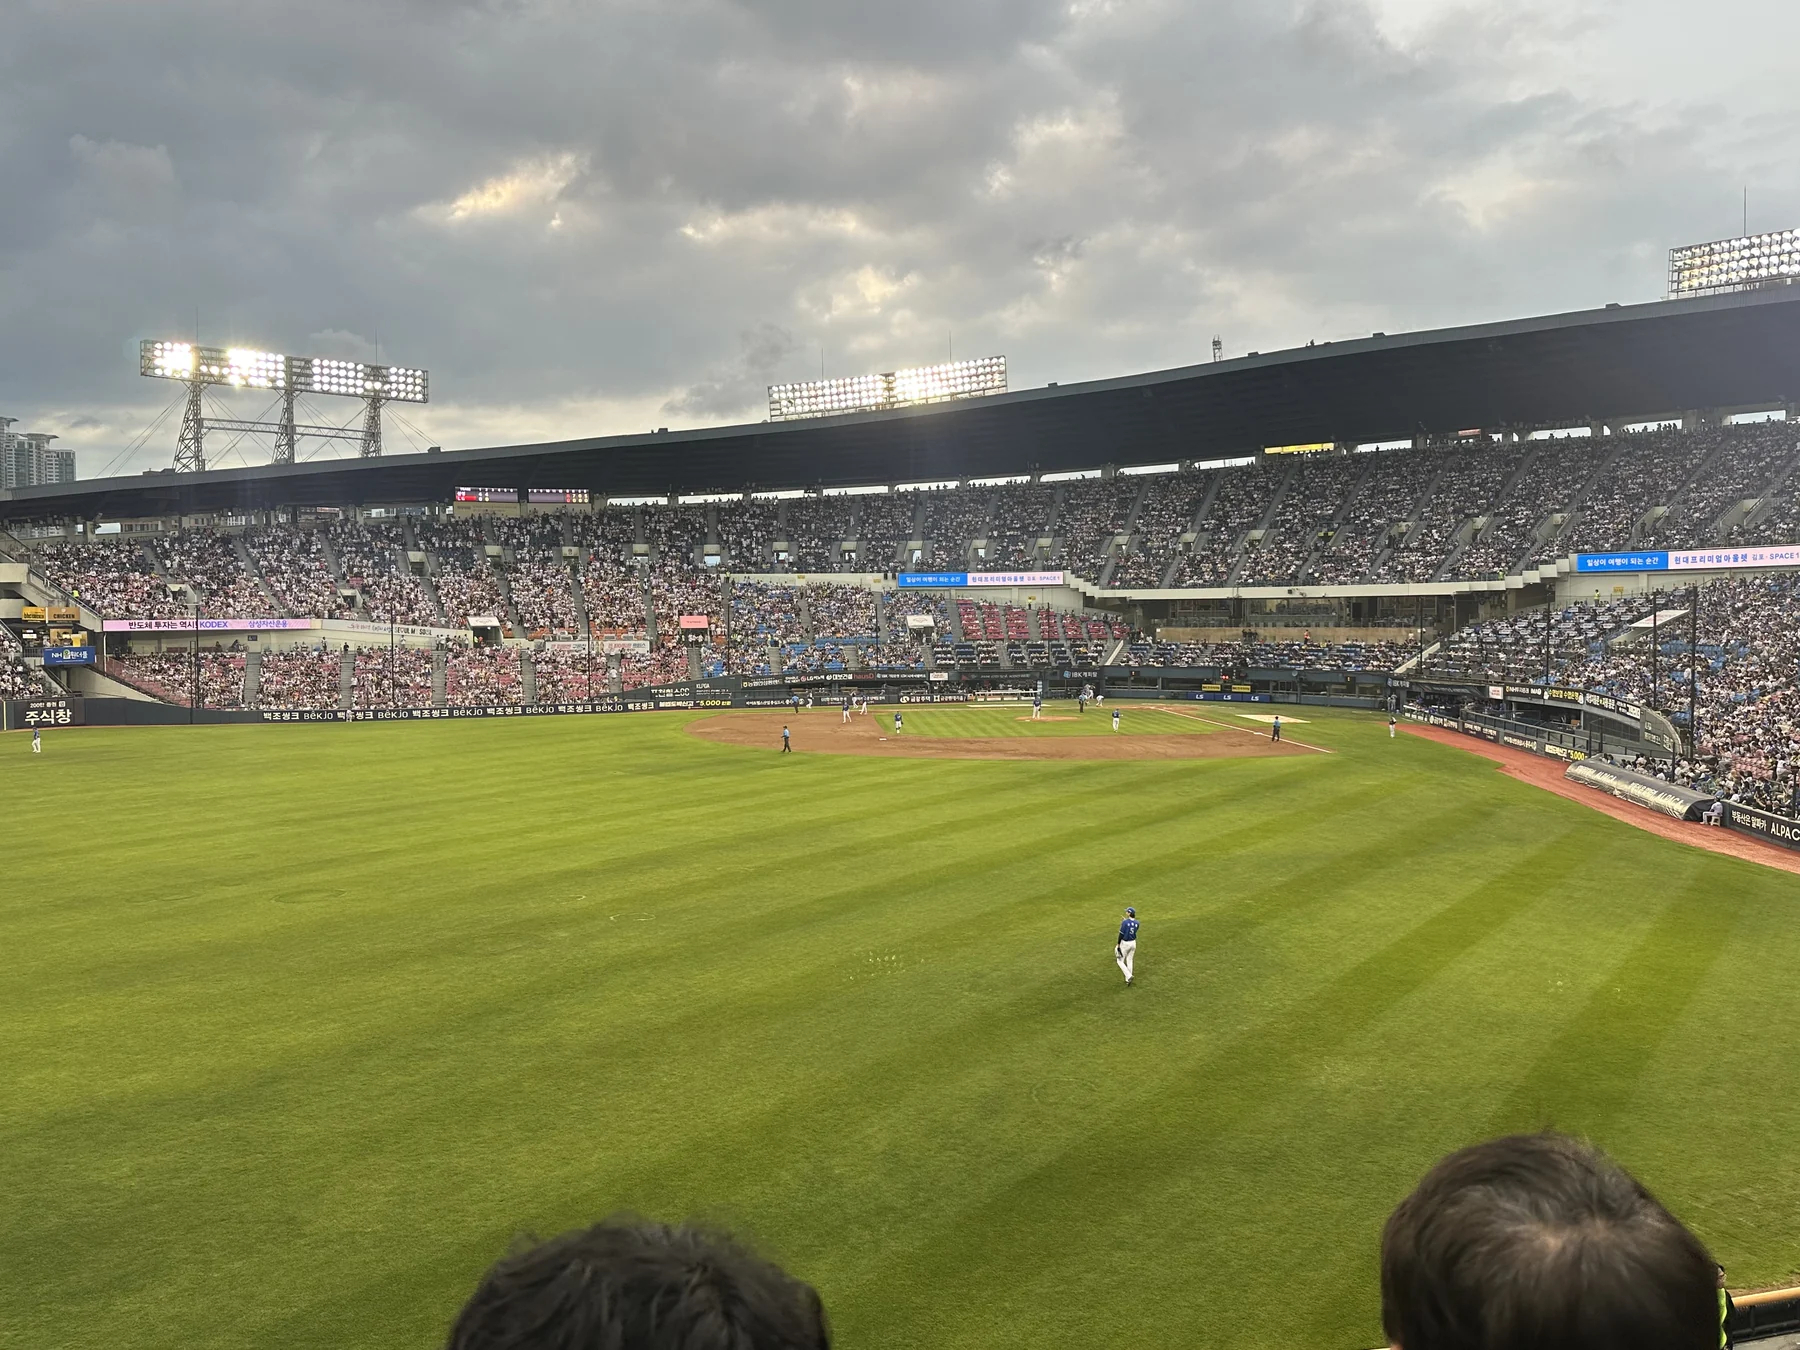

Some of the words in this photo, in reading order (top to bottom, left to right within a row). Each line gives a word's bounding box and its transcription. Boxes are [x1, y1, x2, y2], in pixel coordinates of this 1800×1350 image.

[1608, 558, 1628, 566] 여행이
[1674, 554, 1748, 565] 현대프리미엄아울렛
[248, 620, 288, 628] 삼성자산운용
[558, 705, 592, 713] 백조씽크
[628, 702, 654, 710] 백조씽크
[412, 709, 449, 718] 백조씽크
[486, 706, 522, 715] 백조씽크
[24, 708, 72, 726] 주식창
[263, 712, 299, 720] 백조씽크
